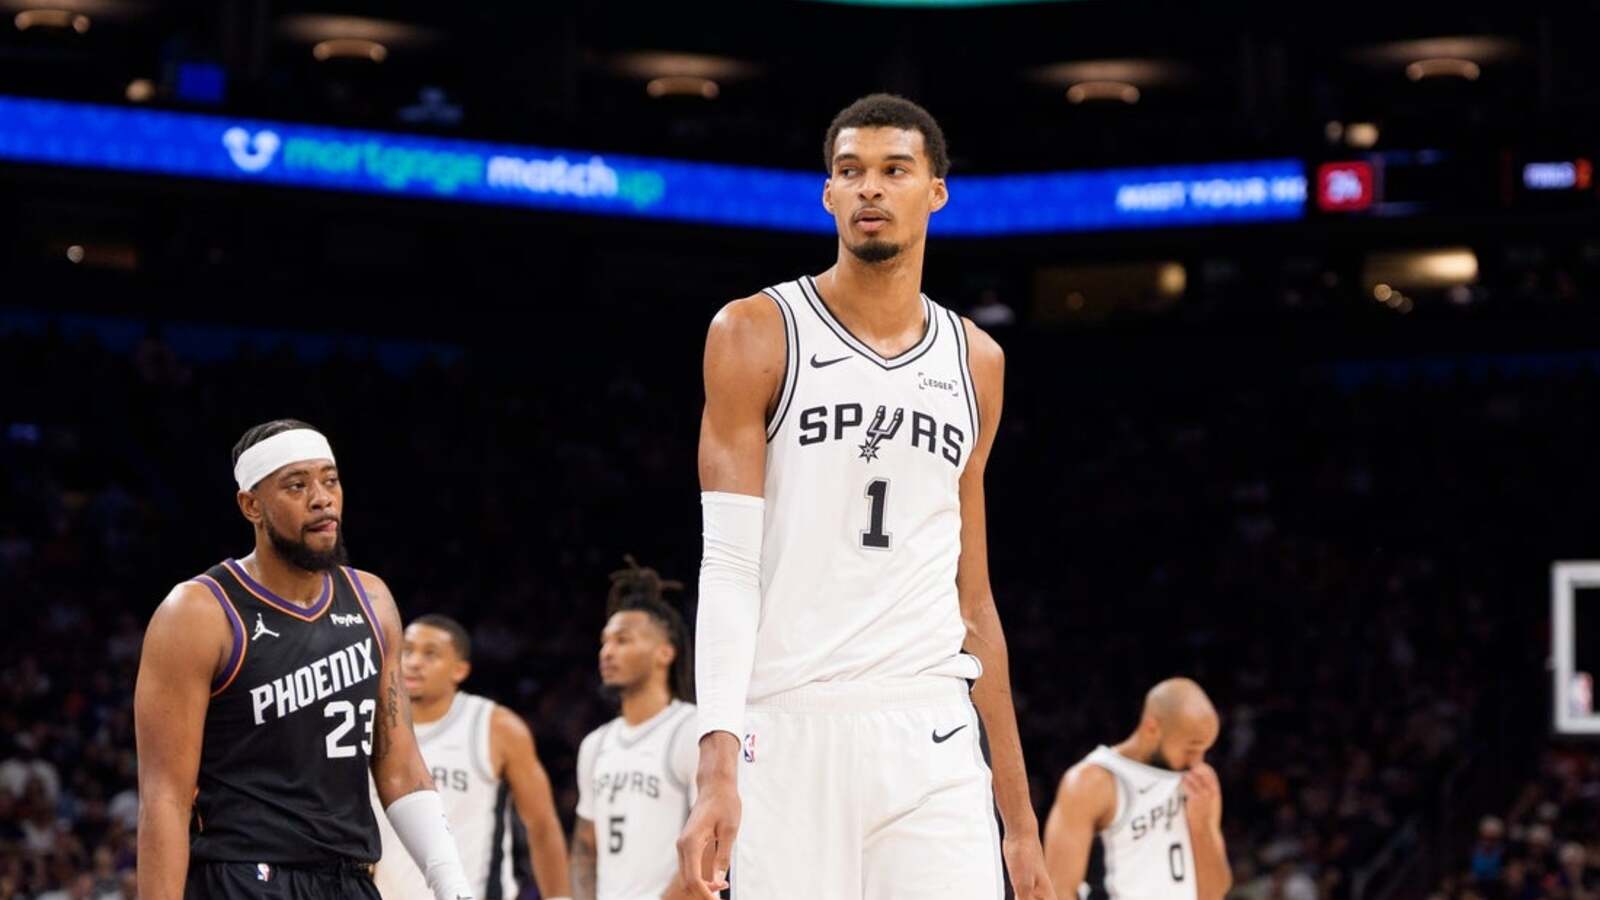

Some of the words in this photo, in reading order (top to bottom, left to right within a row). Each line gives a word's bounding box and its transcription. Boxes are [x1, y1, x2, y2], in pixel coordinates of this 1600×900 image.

[284, 136, 483, 194] mortgage
[923, 378, 953, 391] LEDGER
[799, 402, 964, 467] SPURS
[861, 478, 891, 550] 1
[330, 613, 364, 627] PayPal
[250, 638, 377, 725] PHOENIX
[323, 699, 376, 759] 23
[608, 816, 625, 854] 5
[1131, 797, 1184, 840] SPU
[1169, 843, 1184, 882] 0
